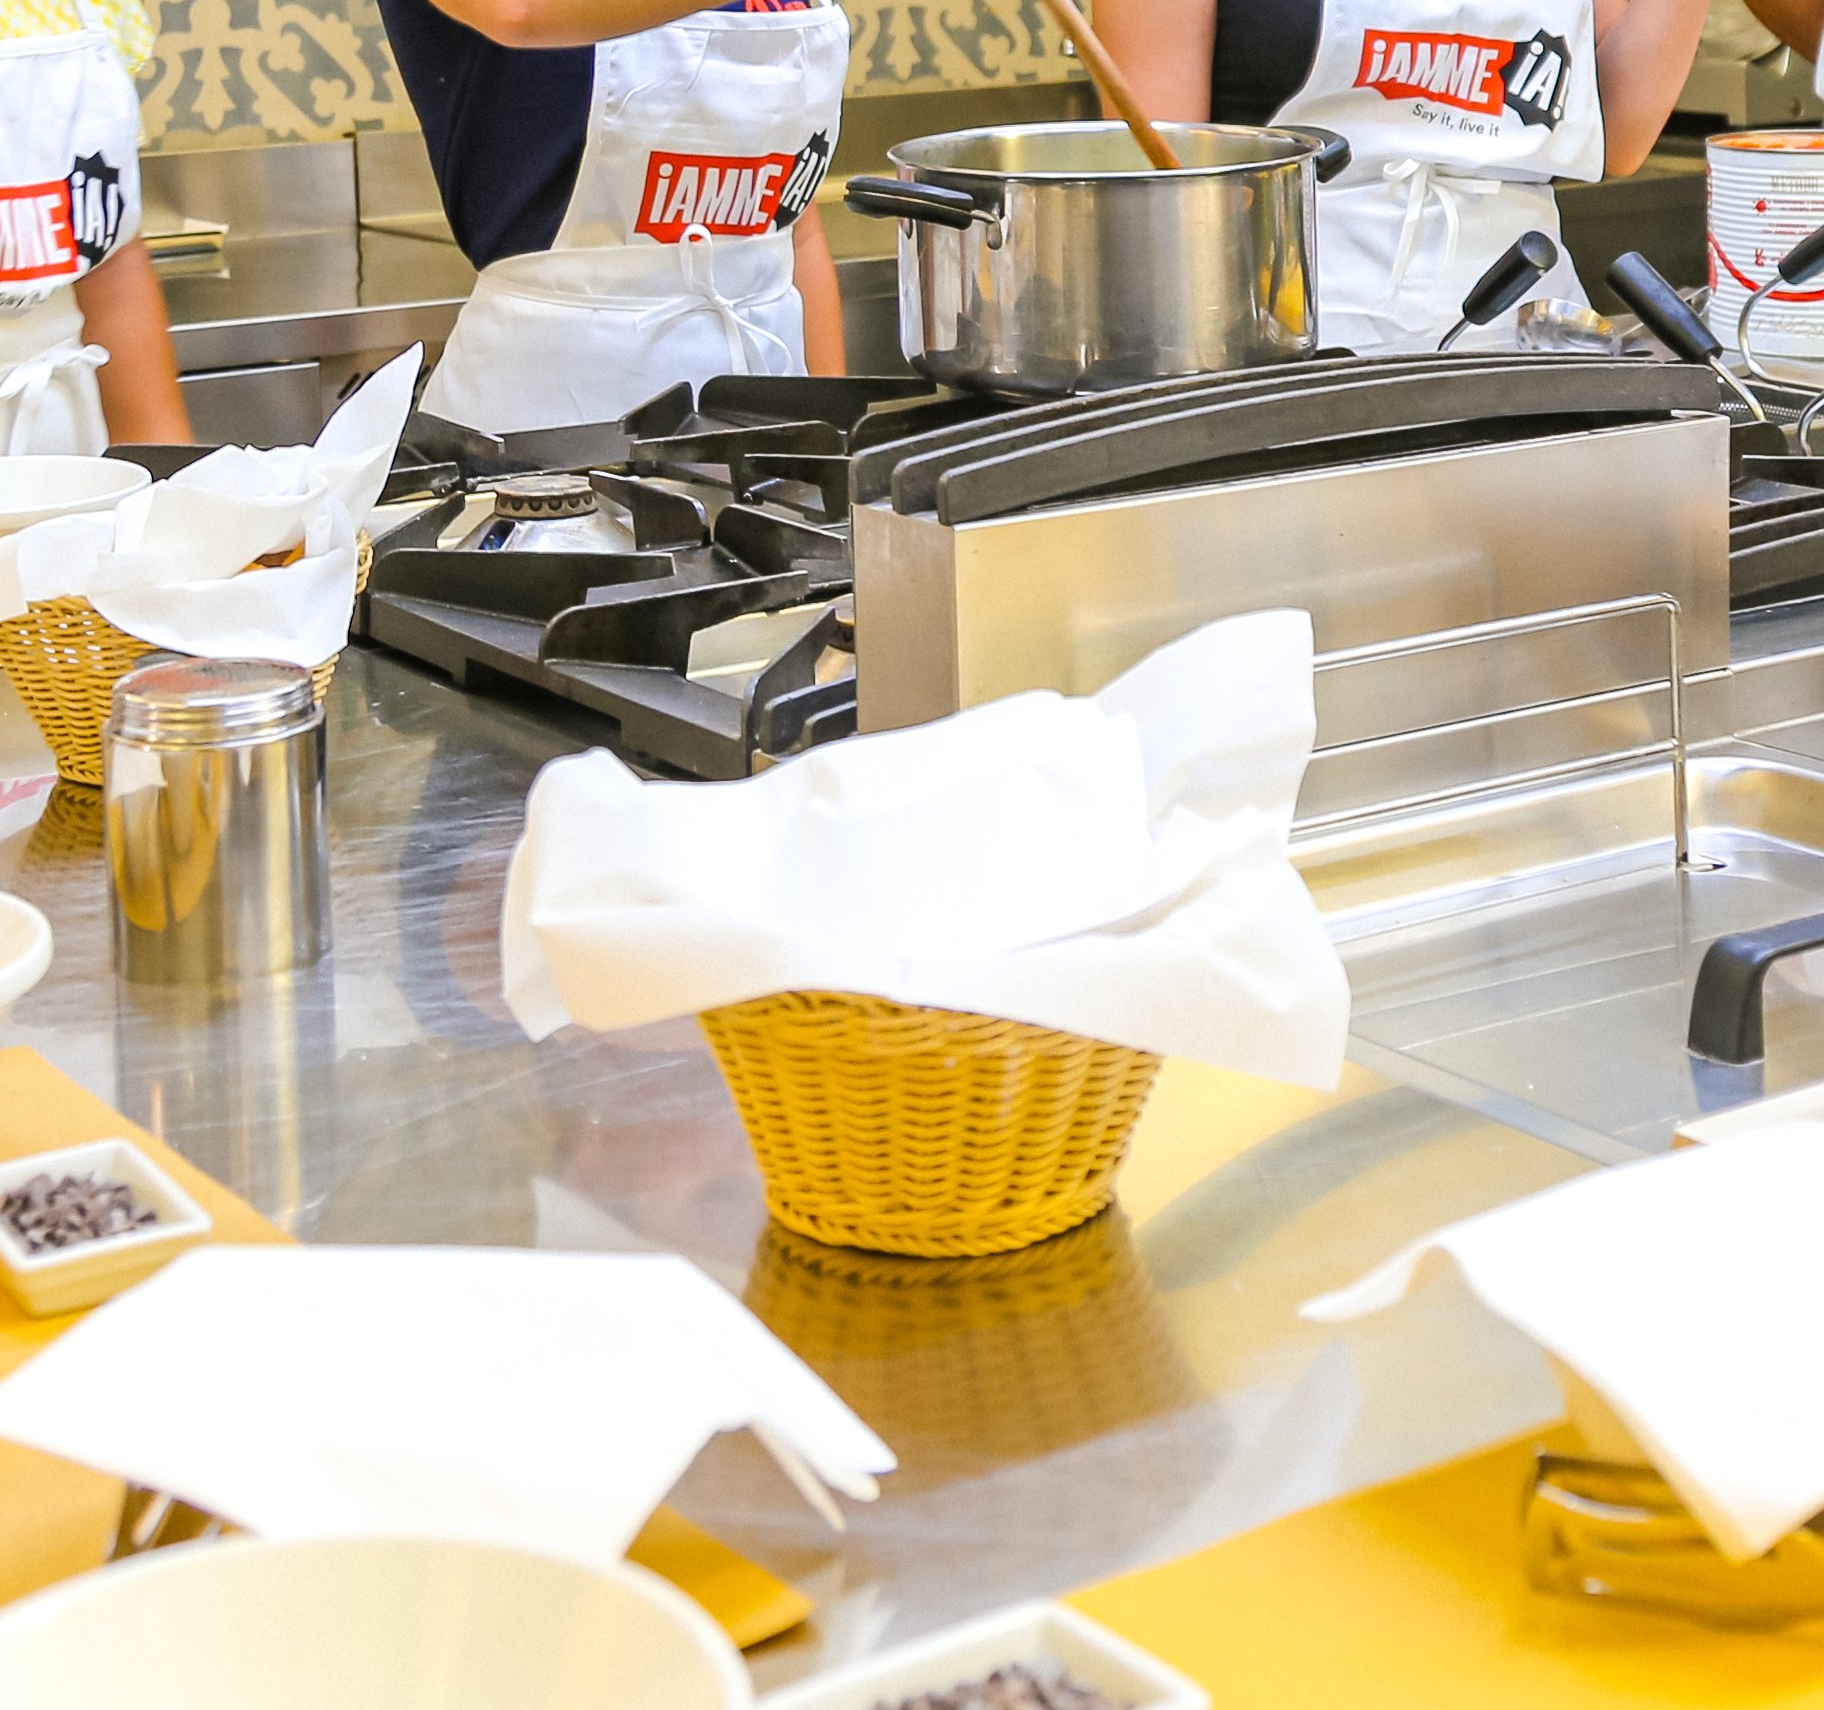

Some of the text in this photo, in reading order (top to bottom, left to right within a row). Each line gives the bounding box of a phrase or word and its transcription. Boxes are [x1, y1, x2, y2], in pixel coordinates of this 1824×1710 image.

[1412, 103, 1437, 124] Say
[1459, 119, 1485, 135] live
[1489, 123, 1500, 137] it
